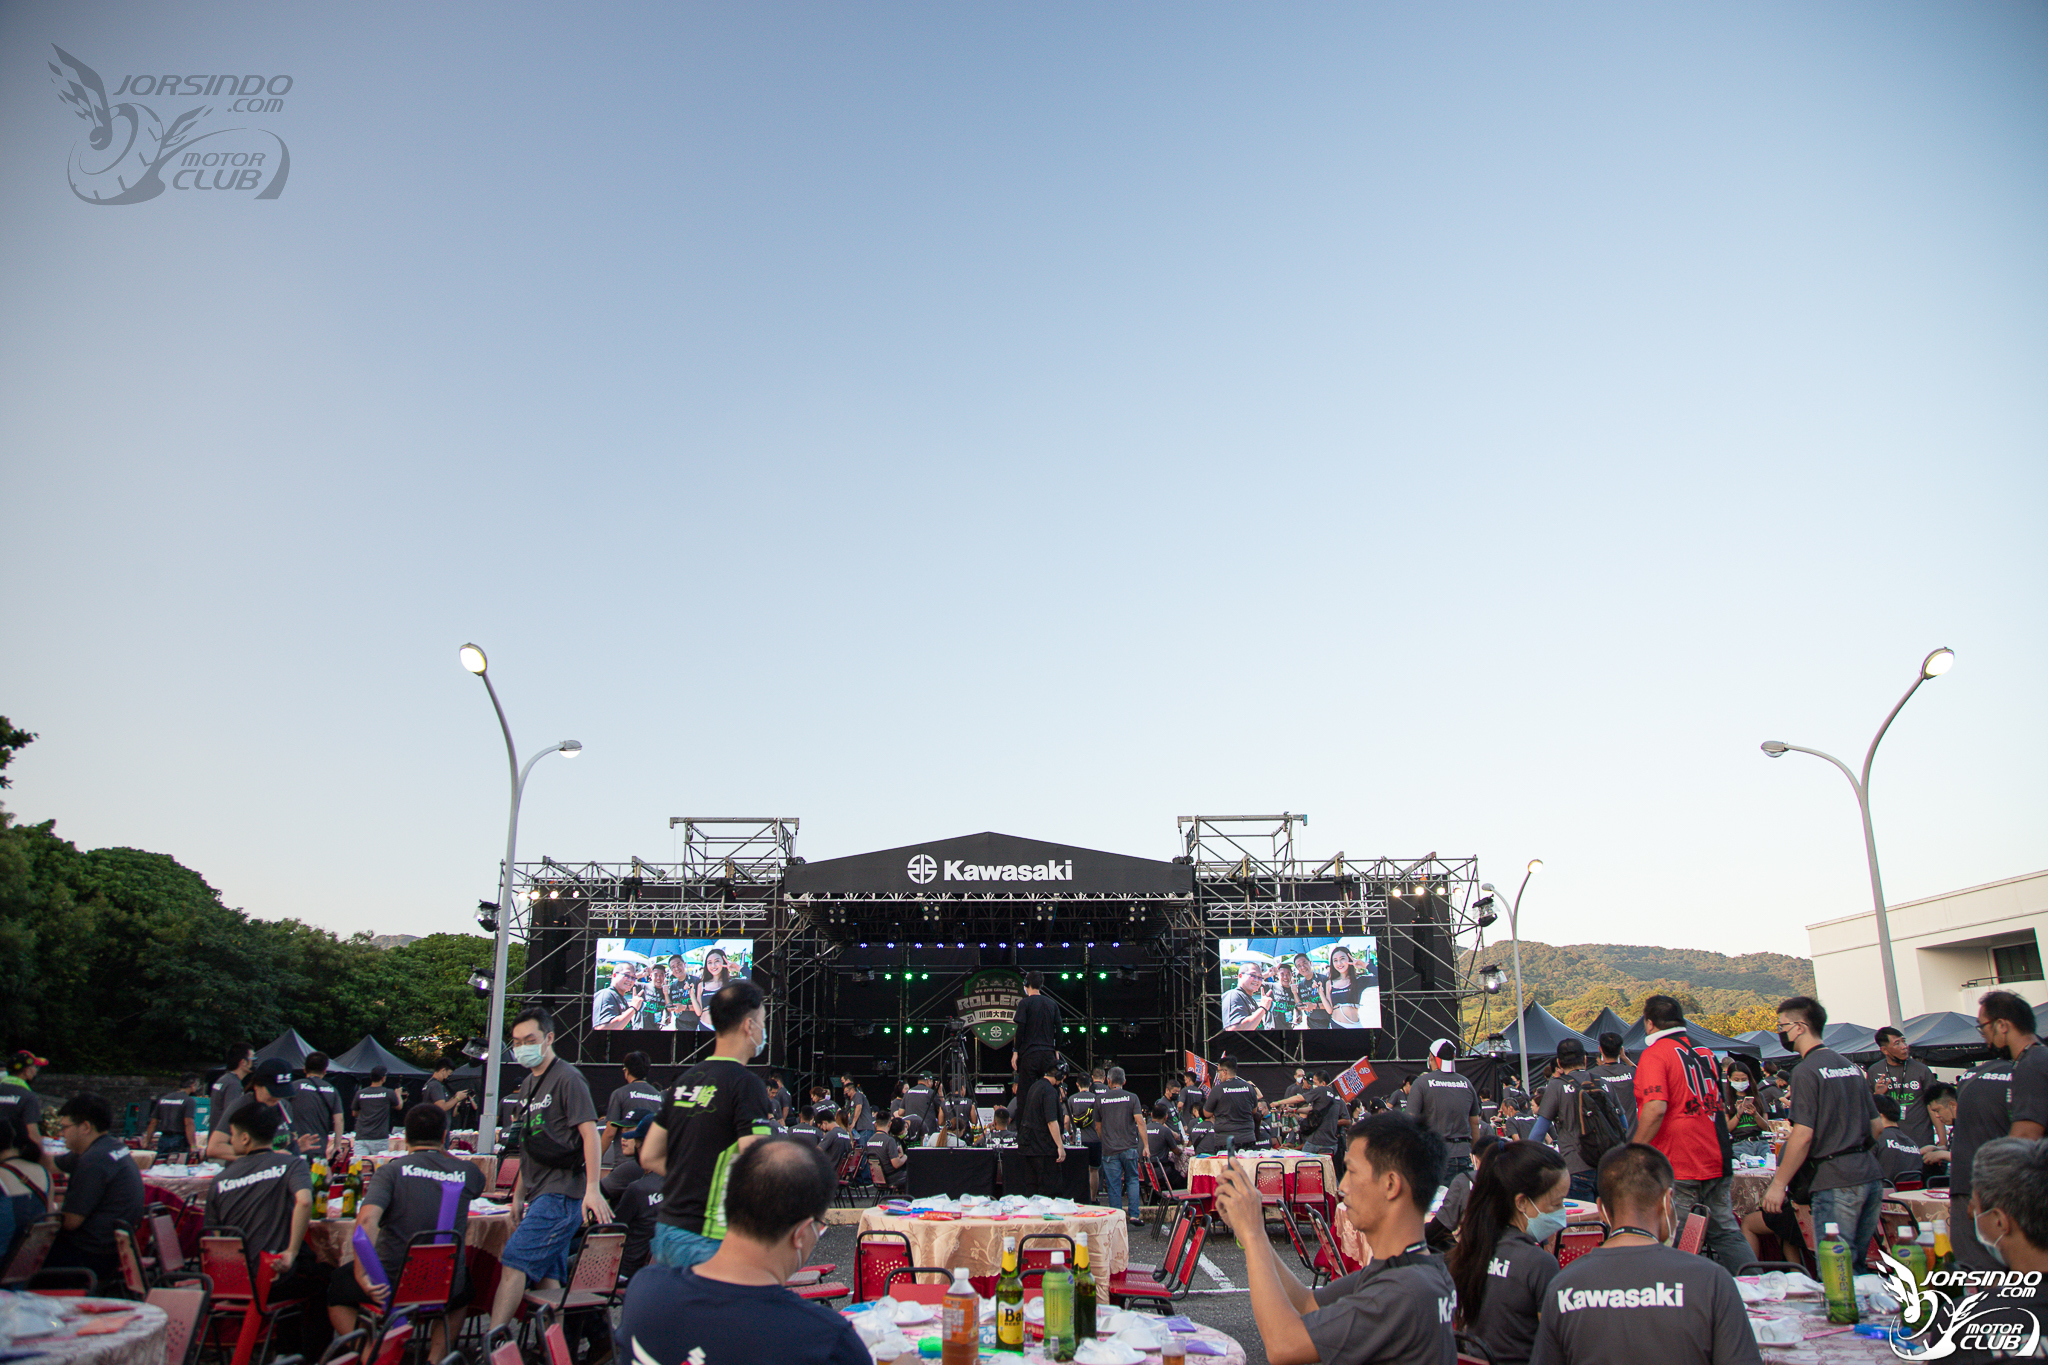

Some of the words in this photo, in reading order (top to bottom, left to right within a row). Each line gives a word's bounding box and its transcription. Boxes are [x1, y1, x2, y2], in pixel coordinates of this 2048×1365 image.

[943, 859, 1073, 881] Kawasaki
[957, 994, 1023, 1010] ROLLER
[1427, 1079, 1469, 1089] Kawasaki
[1600, 1072, 1633, 1083] wasaki
[1100, 1096, 1131, 1105] Kawasaki
[217, 1165, 287, 1194] Kawasaki
[401, 1164, 467, 1184] Kawasaki
[1557, 1282, 1684, 1314] Kawasaki
